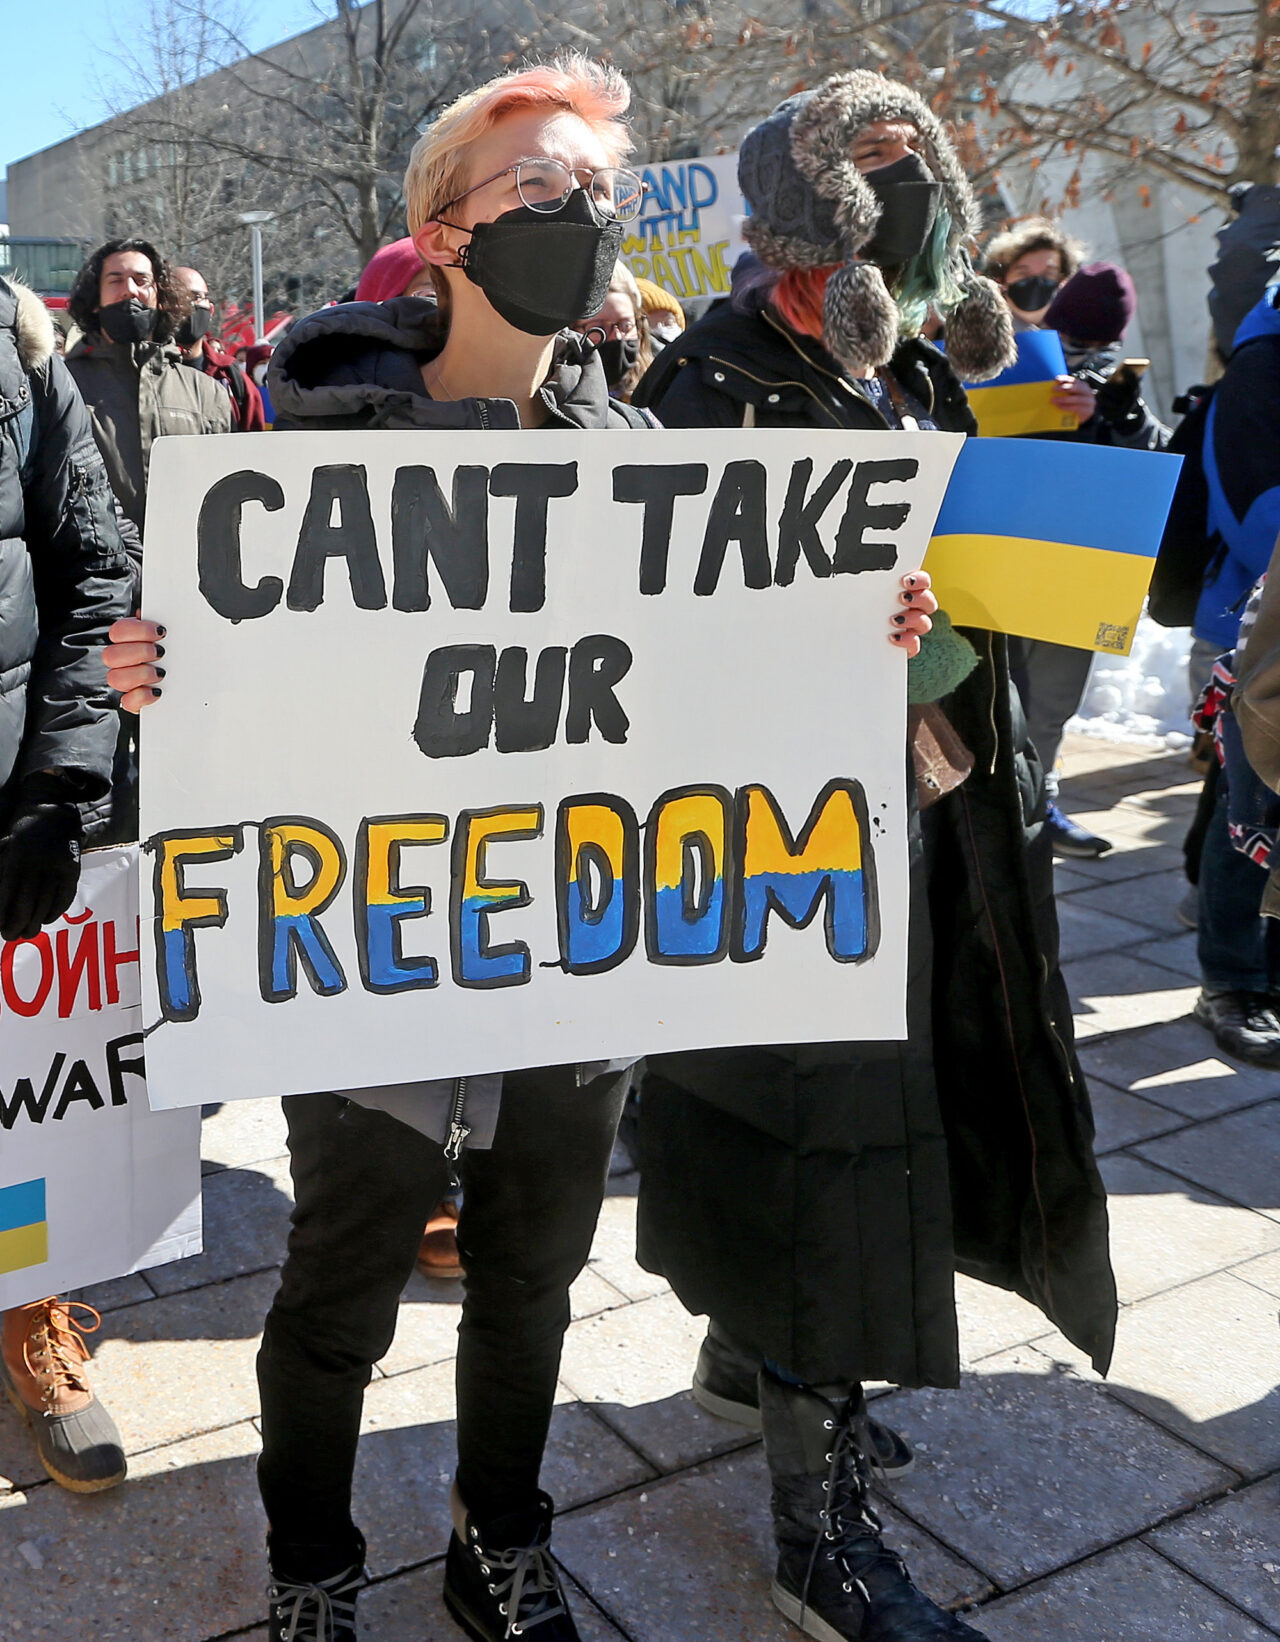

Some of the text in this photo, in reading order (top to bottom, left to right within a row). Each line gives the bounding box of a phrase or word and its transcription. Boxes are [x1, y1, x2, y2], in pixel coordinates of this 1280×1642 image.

[635, 163, 718, 216] AND
[627, 240, 732, 298] RAINE
[197, 457, 918, 624] CANT TAKE
[411, 635, 632, 758] OUR
[144, 778, 880, 1033] FREEDOM
